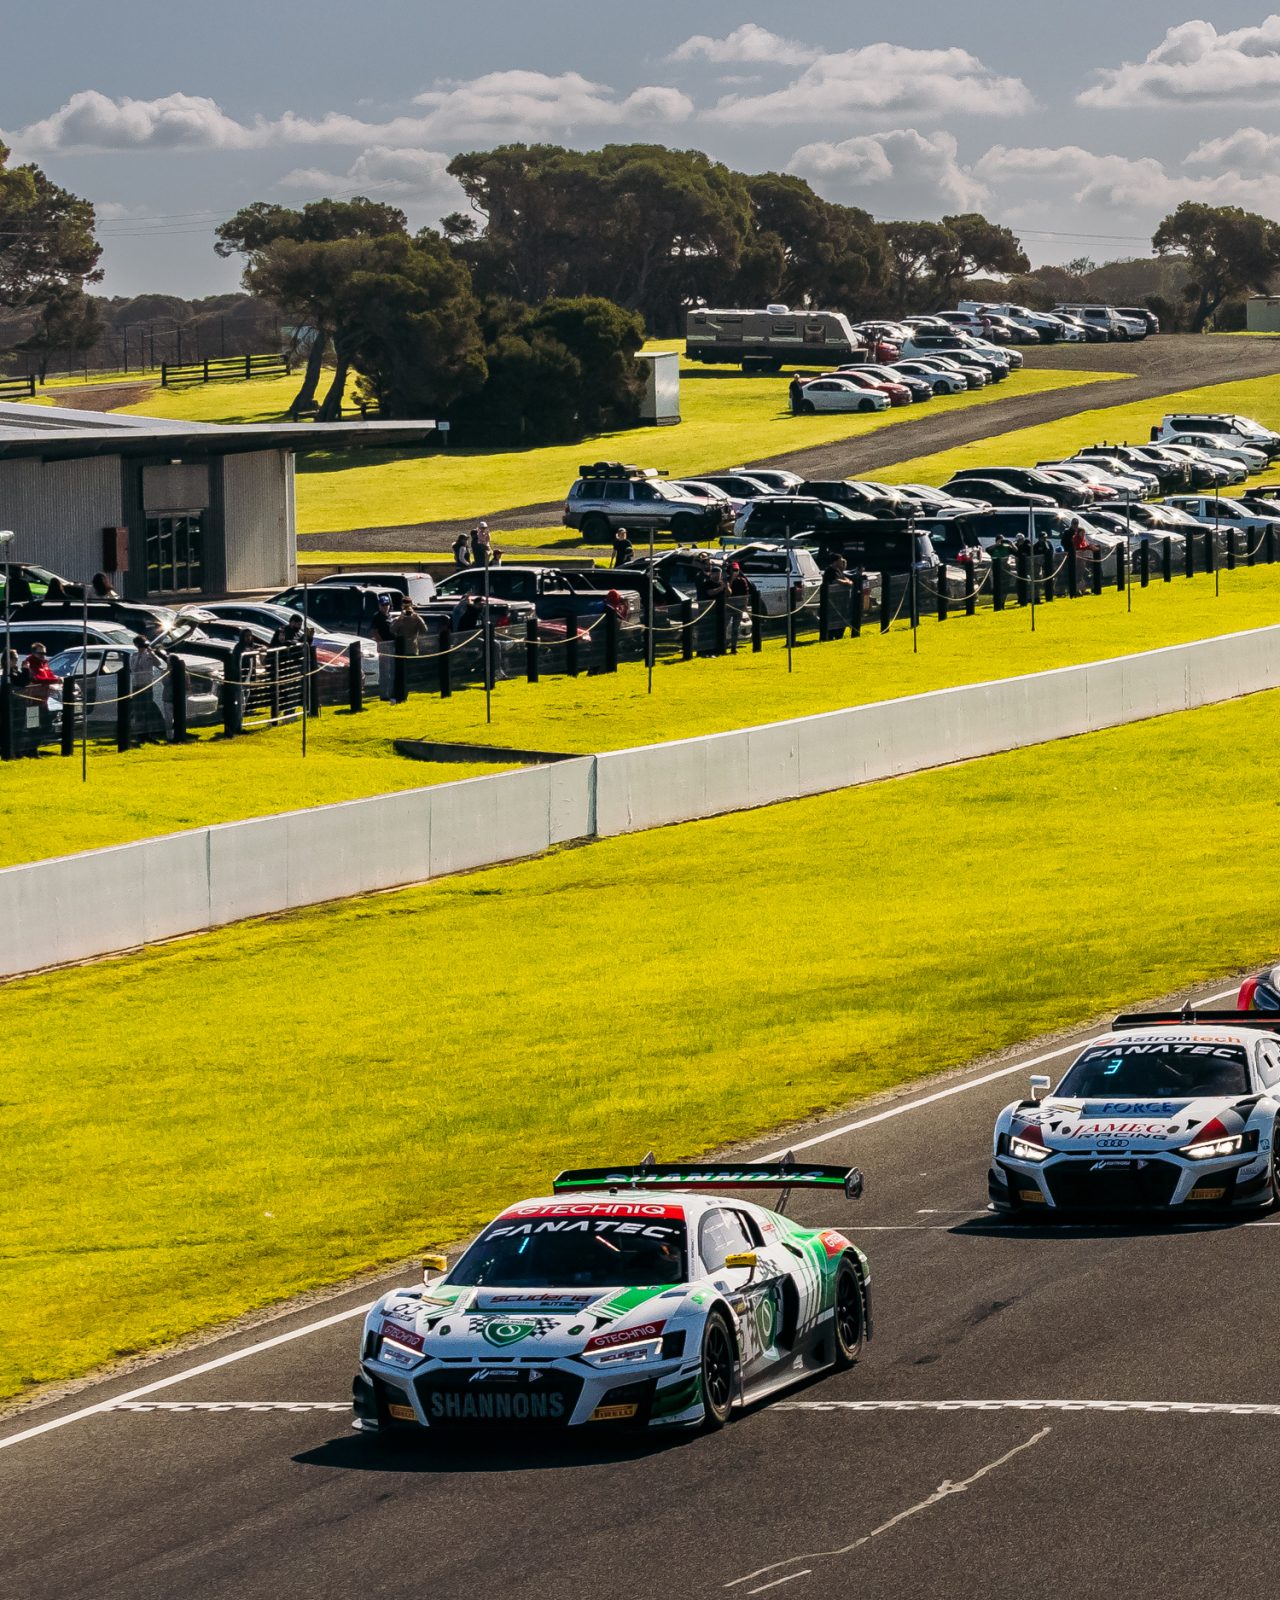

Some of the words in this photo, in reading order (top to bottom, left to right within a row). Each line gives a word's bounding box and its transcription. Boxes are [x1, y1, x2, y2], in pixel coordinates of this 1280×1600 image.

[1083, 1044, 1238, 1063] FANATEC
[1104, 1059, 1123, 1075] 3
[1102, 1101, 1172, 1114] FORCE
[1068, 1122, 1166, 1140] JAMEC
[1077, 1132, 1170, 1141] RACING
[517, 1204, 666, 1215] GTECHNIQ
[484, 1220, 678, 1242] FANATEC
[594, 1325, 657, 1346] GTECHNIQ
[431, 1391, 566, 1419] SHANNONS
